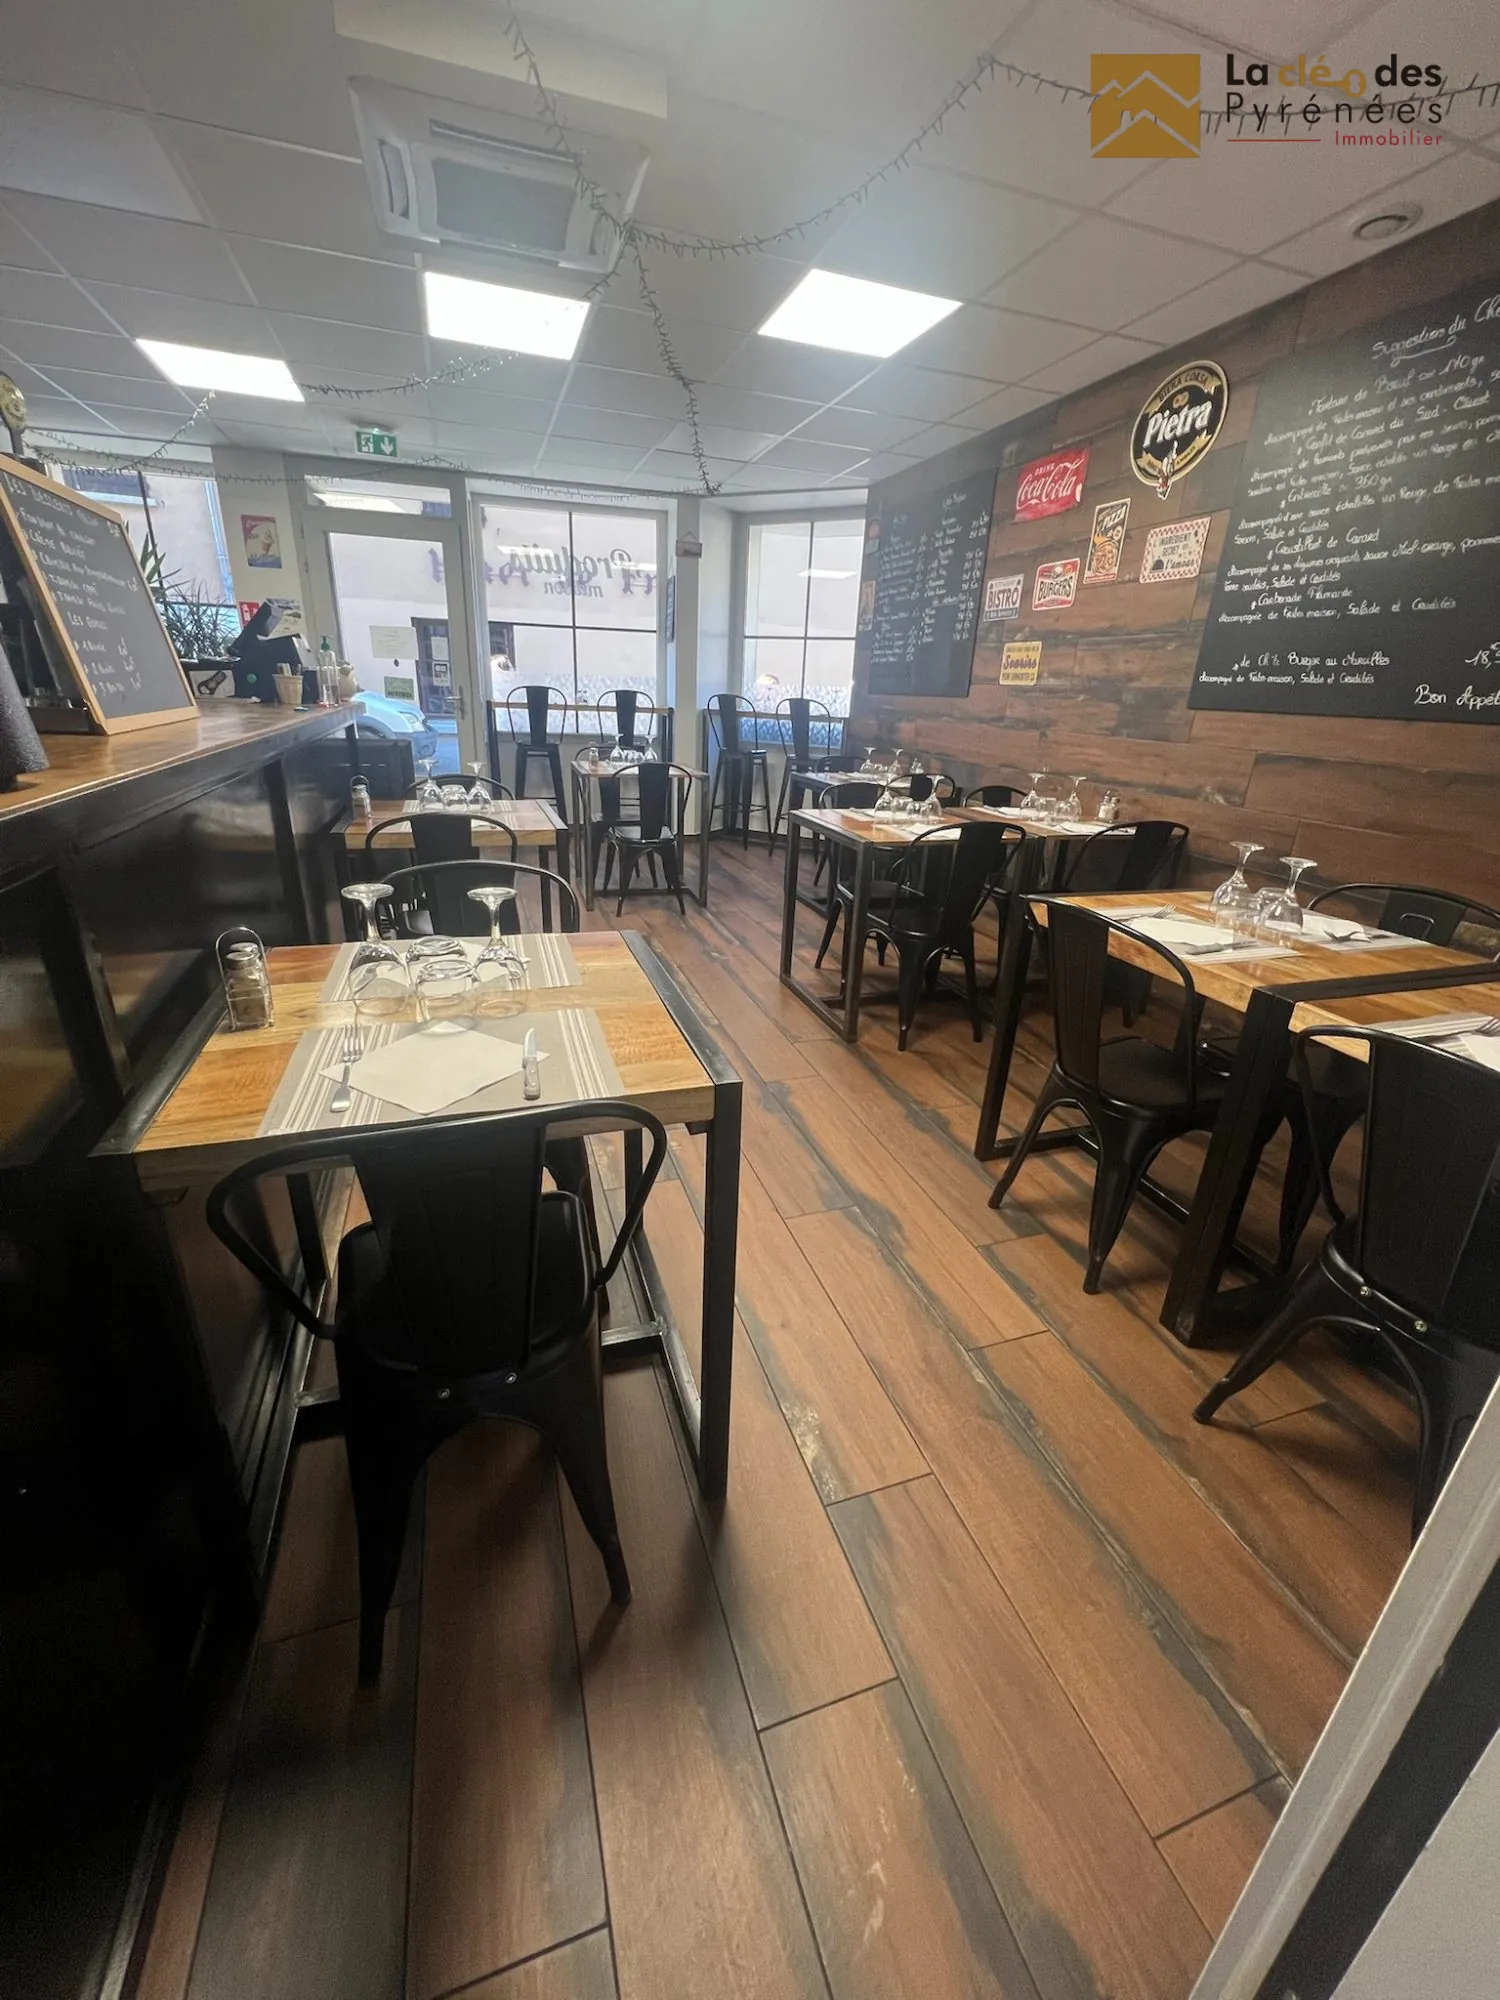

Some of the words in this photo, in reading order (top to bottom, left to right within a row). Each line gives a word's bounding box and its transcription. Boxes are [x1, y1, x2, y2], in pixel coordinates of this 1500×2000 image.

[1448, 314, 1467, 334] du
[1354, 388, 1368, 402] de
[1415, 404, 1440, 422] Sud
[1143, 401, 1213, 448] Pietra
[1327, 536, 1339, 548] de
[1346, 526, 1380, 545] Canard
[987, 587, 1019, 609] BISTRO
[1039, 575, 1074, 602] BURGERS
[1346, 600, 1381, 616] Salade
[1391, 600, 1401, 613] et
[1287, 651, 1321, 673] Burger
[1325, 656, 1338, 666] au
[1327, 672, 1336, 684] et
[1414, 684, 1447, 704] Bon
